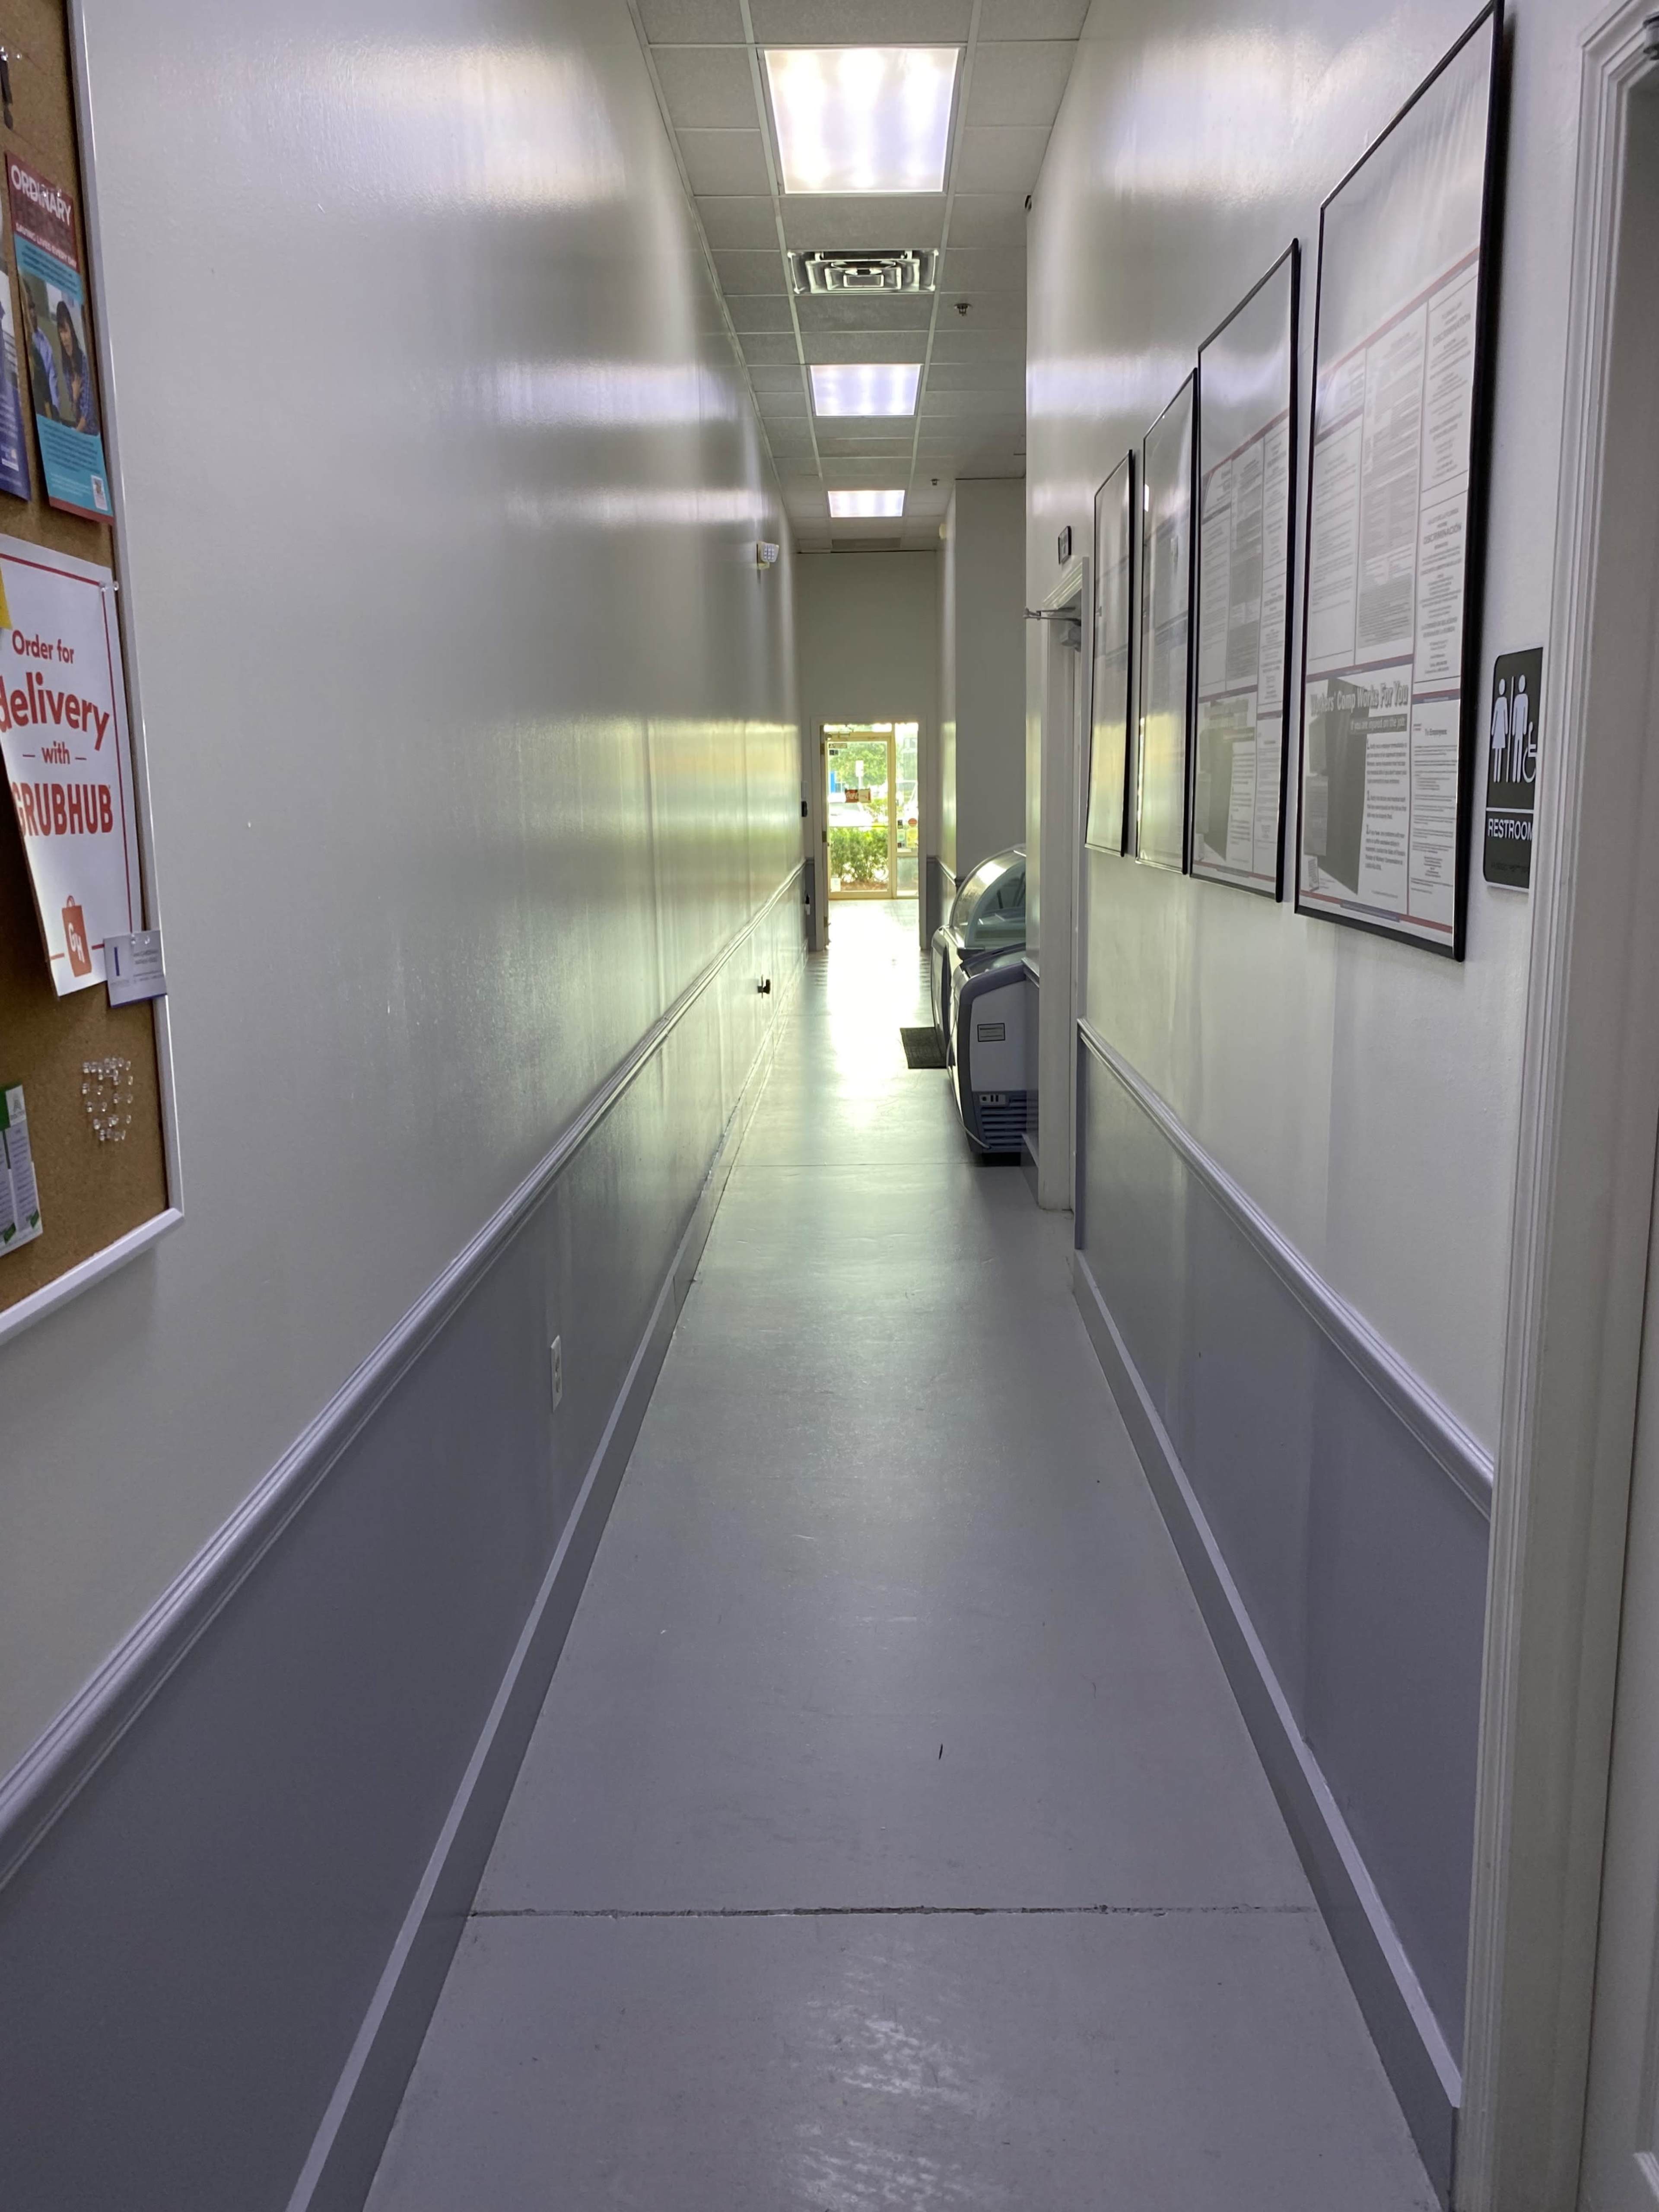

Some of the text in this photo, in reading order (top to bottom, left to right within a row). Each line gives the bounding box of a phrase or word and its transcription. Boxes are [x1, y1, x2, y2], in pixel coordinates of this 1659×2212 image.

[11, 165, 71, 226] ORDINARY
[12, 630, 74, 664] Order for
[1337, 690, 1356, 714] Comp
[1357, 684, 1379, 709] Works
[1380, 683, 1393, 709] For
[1394, 680, 1409, 707] You
[42, 741, 70, 765] with
[12, 782, 113, 836] GRUBHUB
